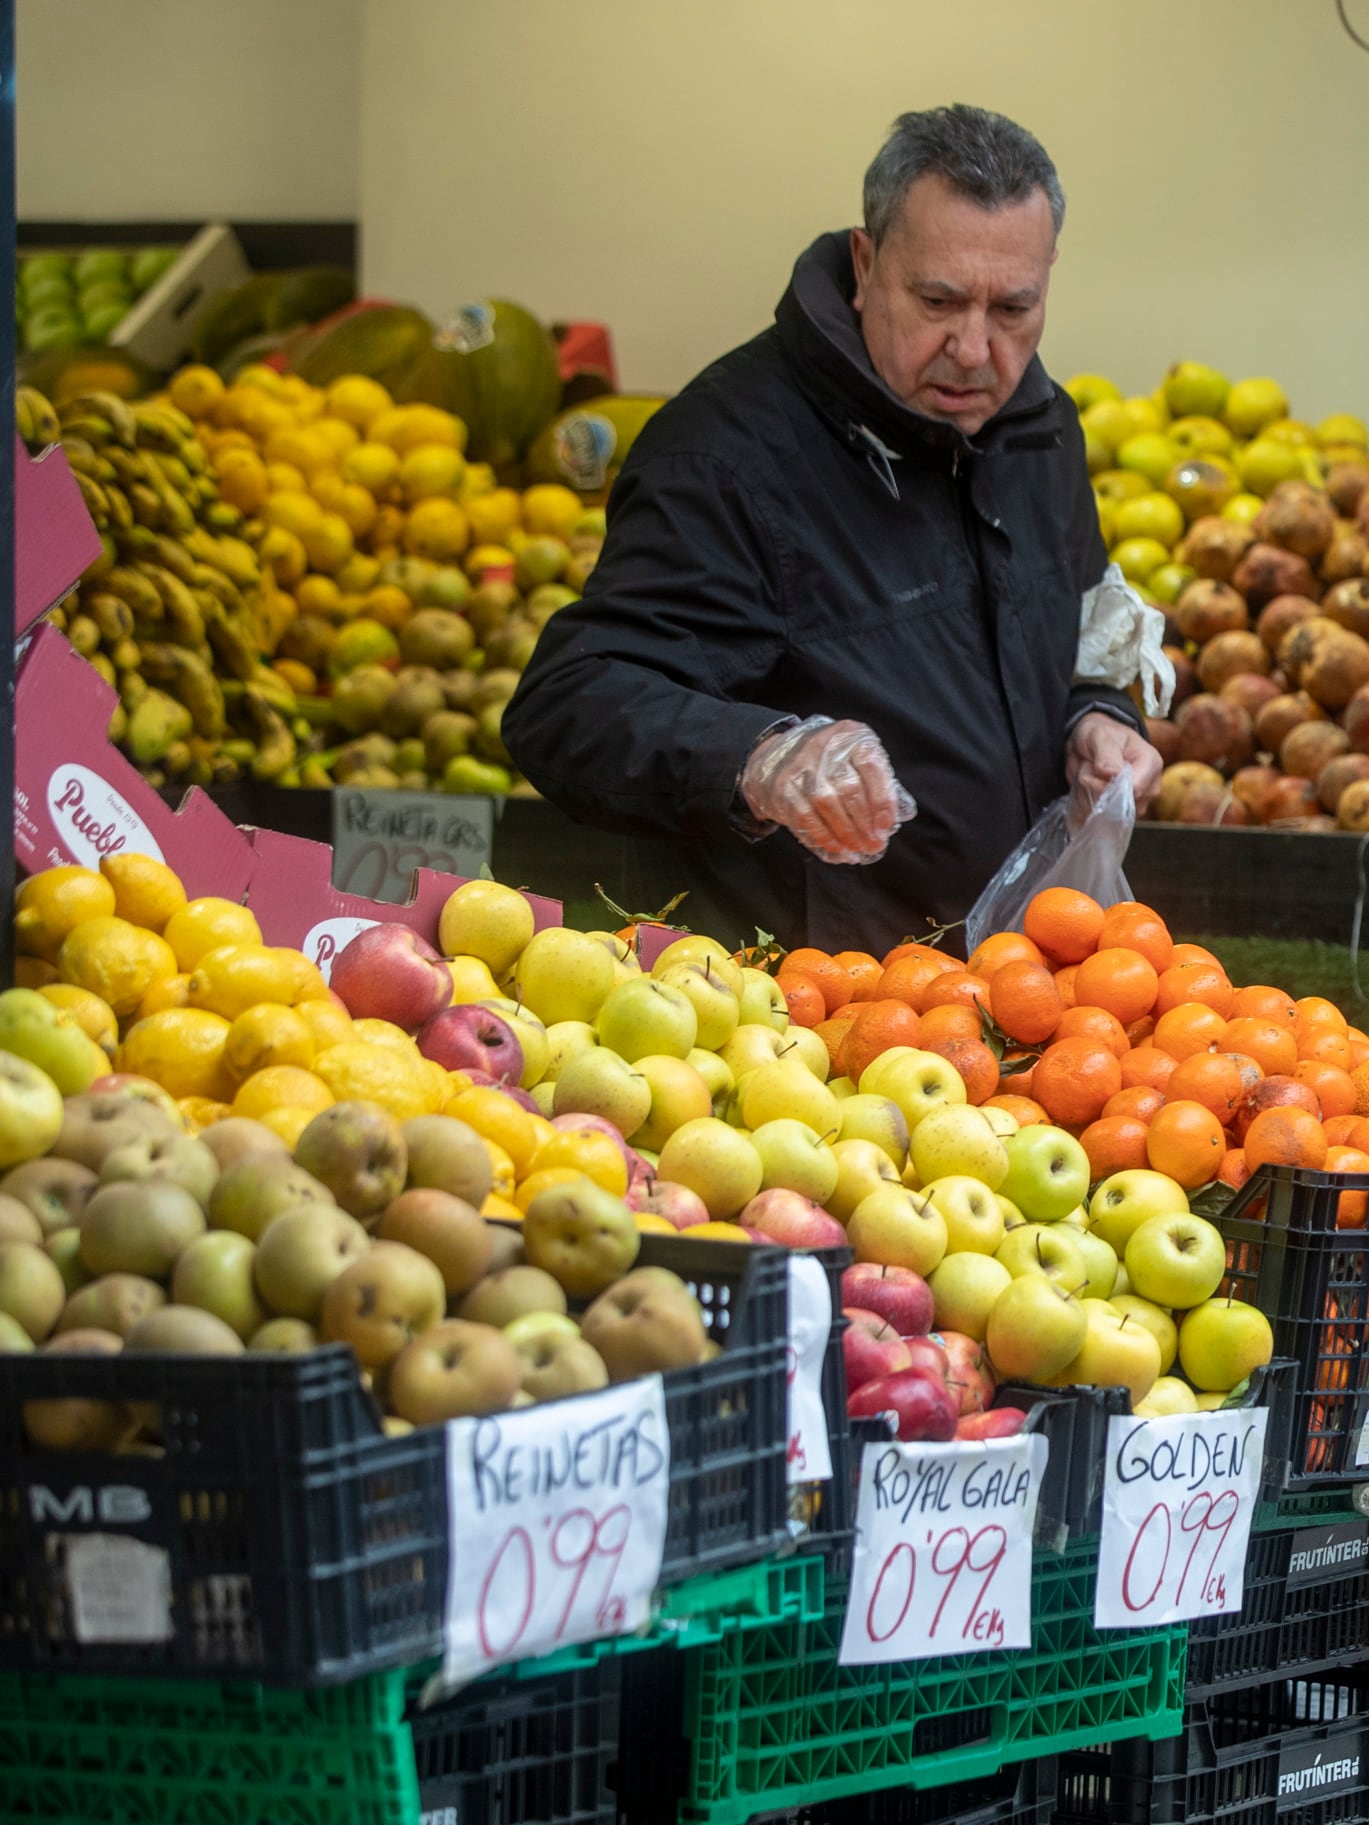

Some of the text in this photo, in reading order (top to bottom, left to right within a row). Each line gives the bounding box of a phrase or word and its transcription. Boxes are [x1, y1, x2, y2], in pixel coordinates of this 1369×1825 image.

[54, 778, 127, 856] Puebl
[471, 1411, 665, 1512] REINETAS
[874, 1448, 1031, 1524] ROYAL GALA
[1116, 1420, 1257, 1491] GOLDEN
[477, 1504, 633, 1658] 0'99
[866, 1524, 1008, 1643] 0'99
[1121, 1489, 1240, 1612] 0'99
